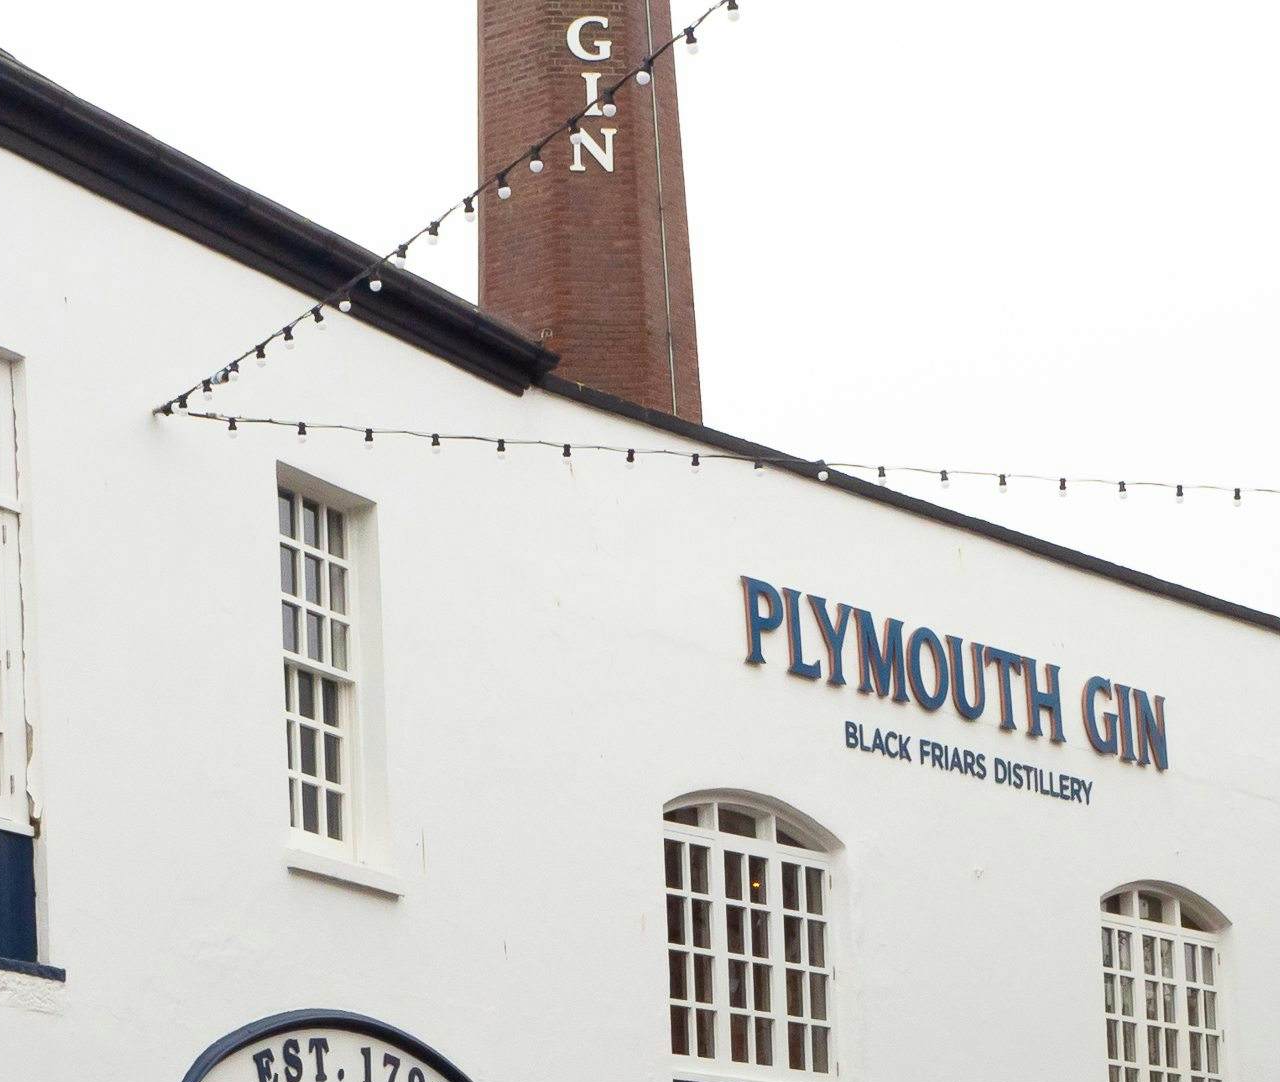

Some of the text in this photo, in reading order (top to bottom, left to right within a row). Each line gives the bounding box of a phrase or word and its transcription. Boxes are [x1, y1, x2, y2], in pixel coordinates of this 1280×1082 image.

[566, 15, 618, 173] GIN
[740, 575, 1169, 772] PLYMOUTH GIN
[845, 720, 1094, 806] BLACK FRIARS DISTILLERY
